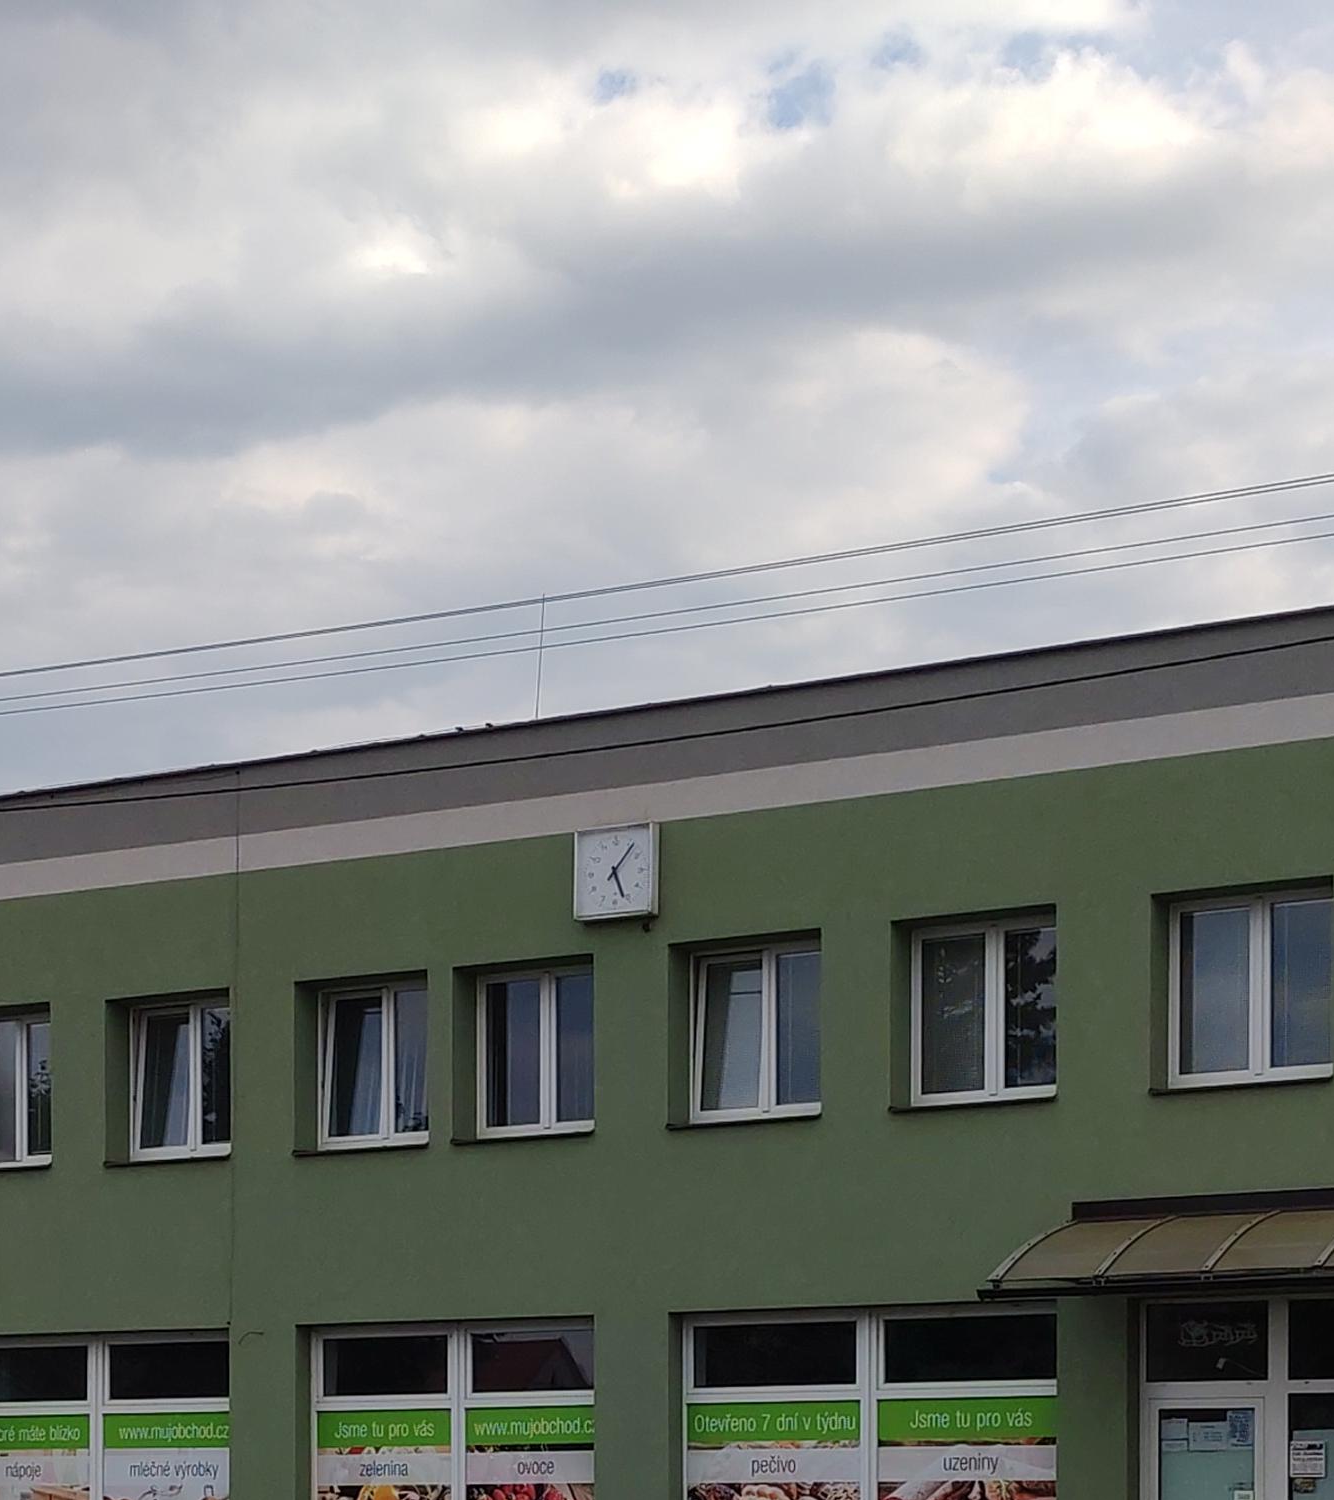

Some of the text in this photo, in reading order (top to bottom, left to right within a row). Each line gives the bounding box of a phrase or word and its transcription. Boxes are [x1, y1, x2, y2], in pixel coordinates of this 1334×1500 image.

[334, 1419, 435, 1440] Jsme tu pro vás
[694, 1411, 856, 1434] Otevřeno 7 dní v týdnu
[909, 1408, 1033, 1431] Jsme tu pro vás
[18, 1427, 46, 1441] máte
[49, 1425, 80, 1441] blízko
[119, 1423, 229, 1442] www.mujobchod.cz
[5, 1462, 42, 1480] nápoje
[129, 1460, 219, 1480] mléčné výrobky
[359, 1460, 408, 1477] zelenina
[517, 1461, 555, 1475] ovoce
[751, 1455, 796, 1477] pečivo
[943, 1453, 999, 1475] uzeniny
